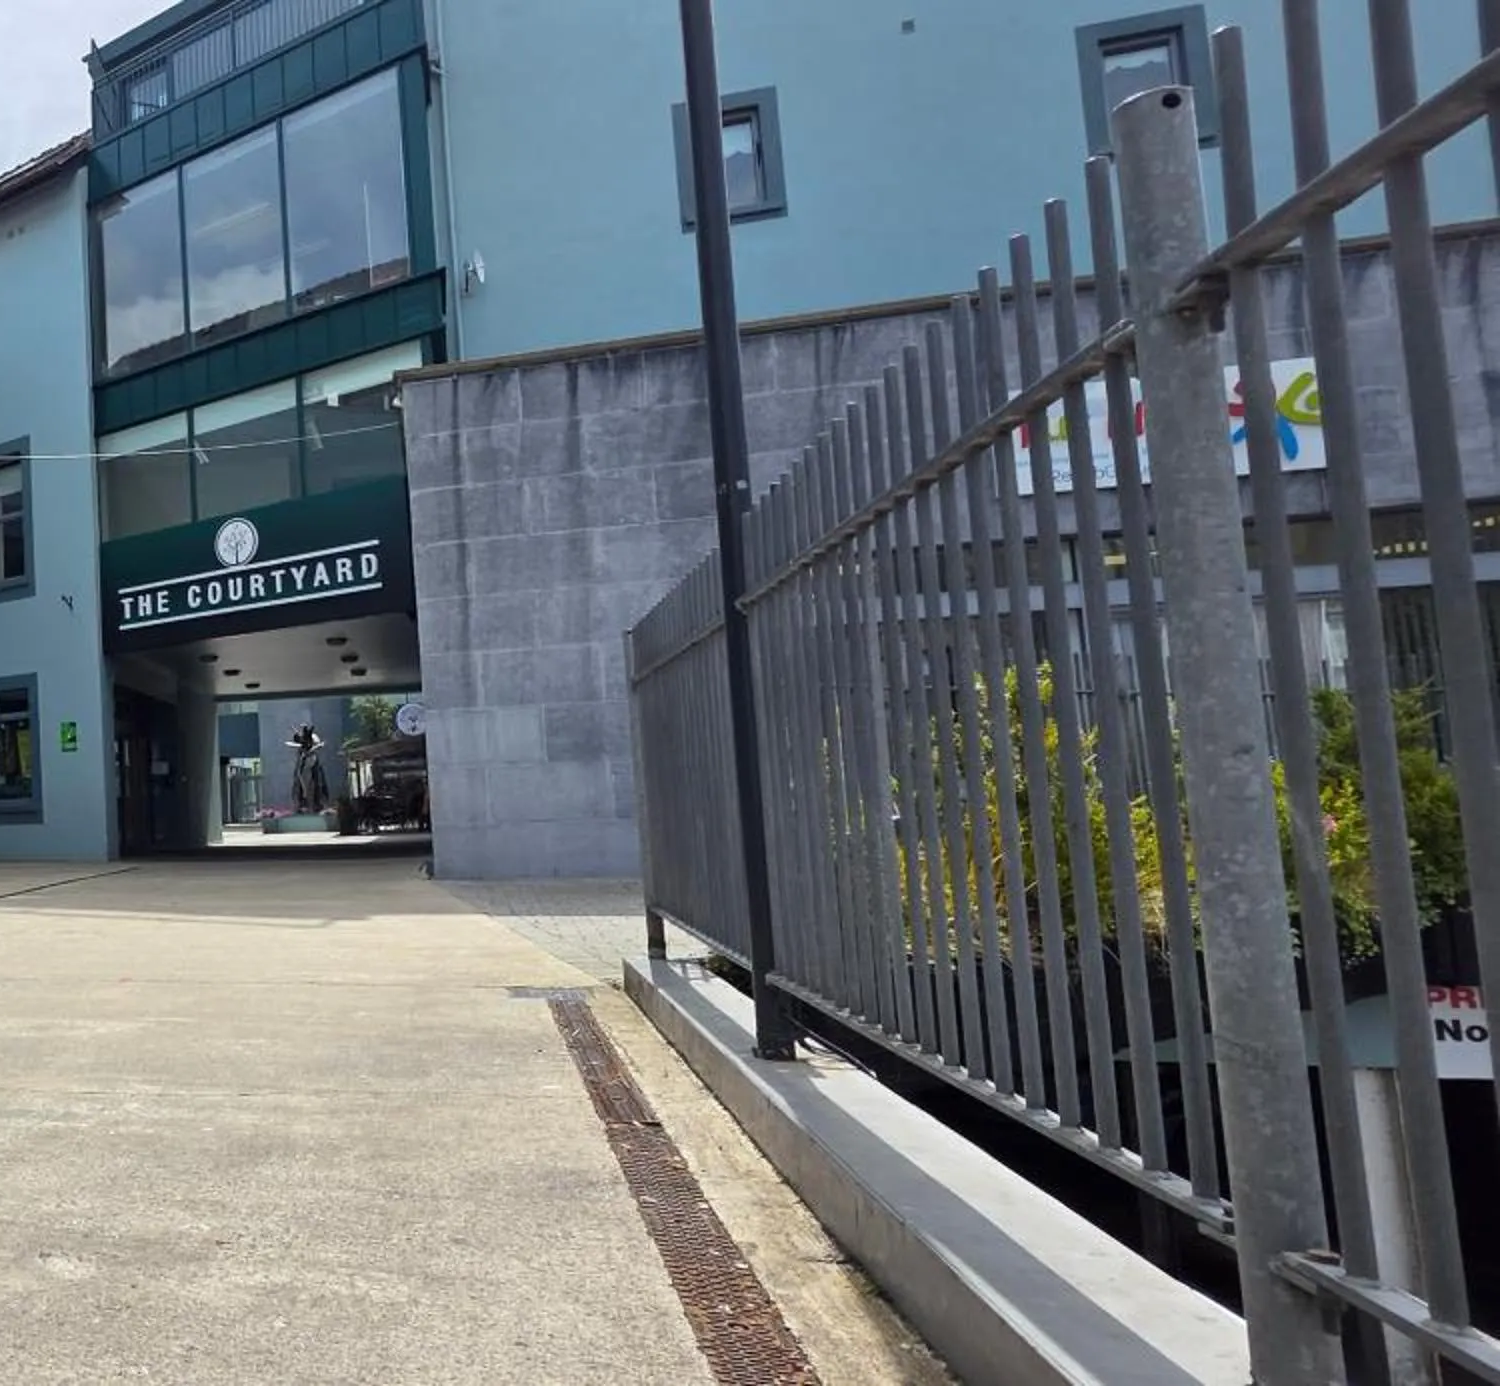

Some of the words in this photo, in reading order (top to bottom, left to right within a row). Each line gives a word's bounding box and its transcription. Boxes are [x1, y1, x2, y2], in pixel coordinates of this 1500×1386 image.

[120, 590, 171, 620] THE
[187, 552, 379, 609] COURTYARD
[1434, 1018, 1490, 1042] No
